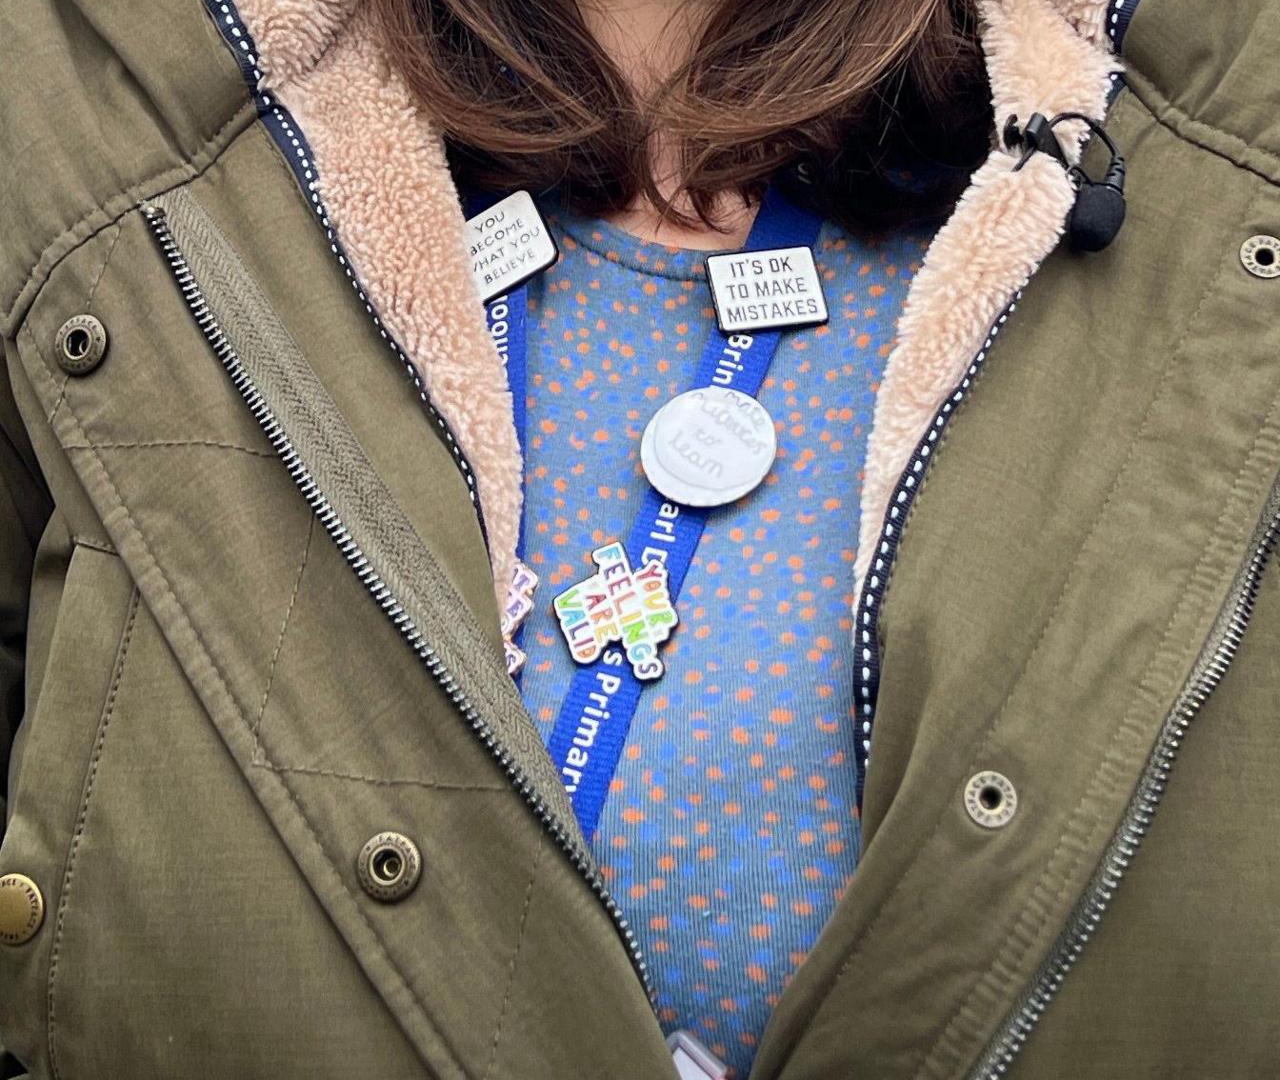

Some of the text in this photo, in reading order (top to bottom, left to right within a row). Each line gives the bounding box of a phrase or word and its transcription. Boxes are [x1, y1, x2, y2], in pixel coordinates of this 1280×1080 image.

[470, 218, 525, 256] BECOME
[475, 210, 505, 233] YOU
[510, 226, 540, 249] YOU
[484, 248, 535, 285] BELIEVE
[730, 256, 793, 278] IT'S OK
[726, 277, 808, 300] TO MAKE
[727, 298, 819, 324] MISTAKES
[712, 334, 754, 385] Brin
[668, 430, 725, 478] learn
[696, 427, 721, 446] to
[650, 503, 680, 543] arl
[597, 546, 658, 675] FEELINGS
[636, 564, 673, 626] YOUR
[558, 589, 597, 660] VALID
[585, 593, 619, 644] ARE
